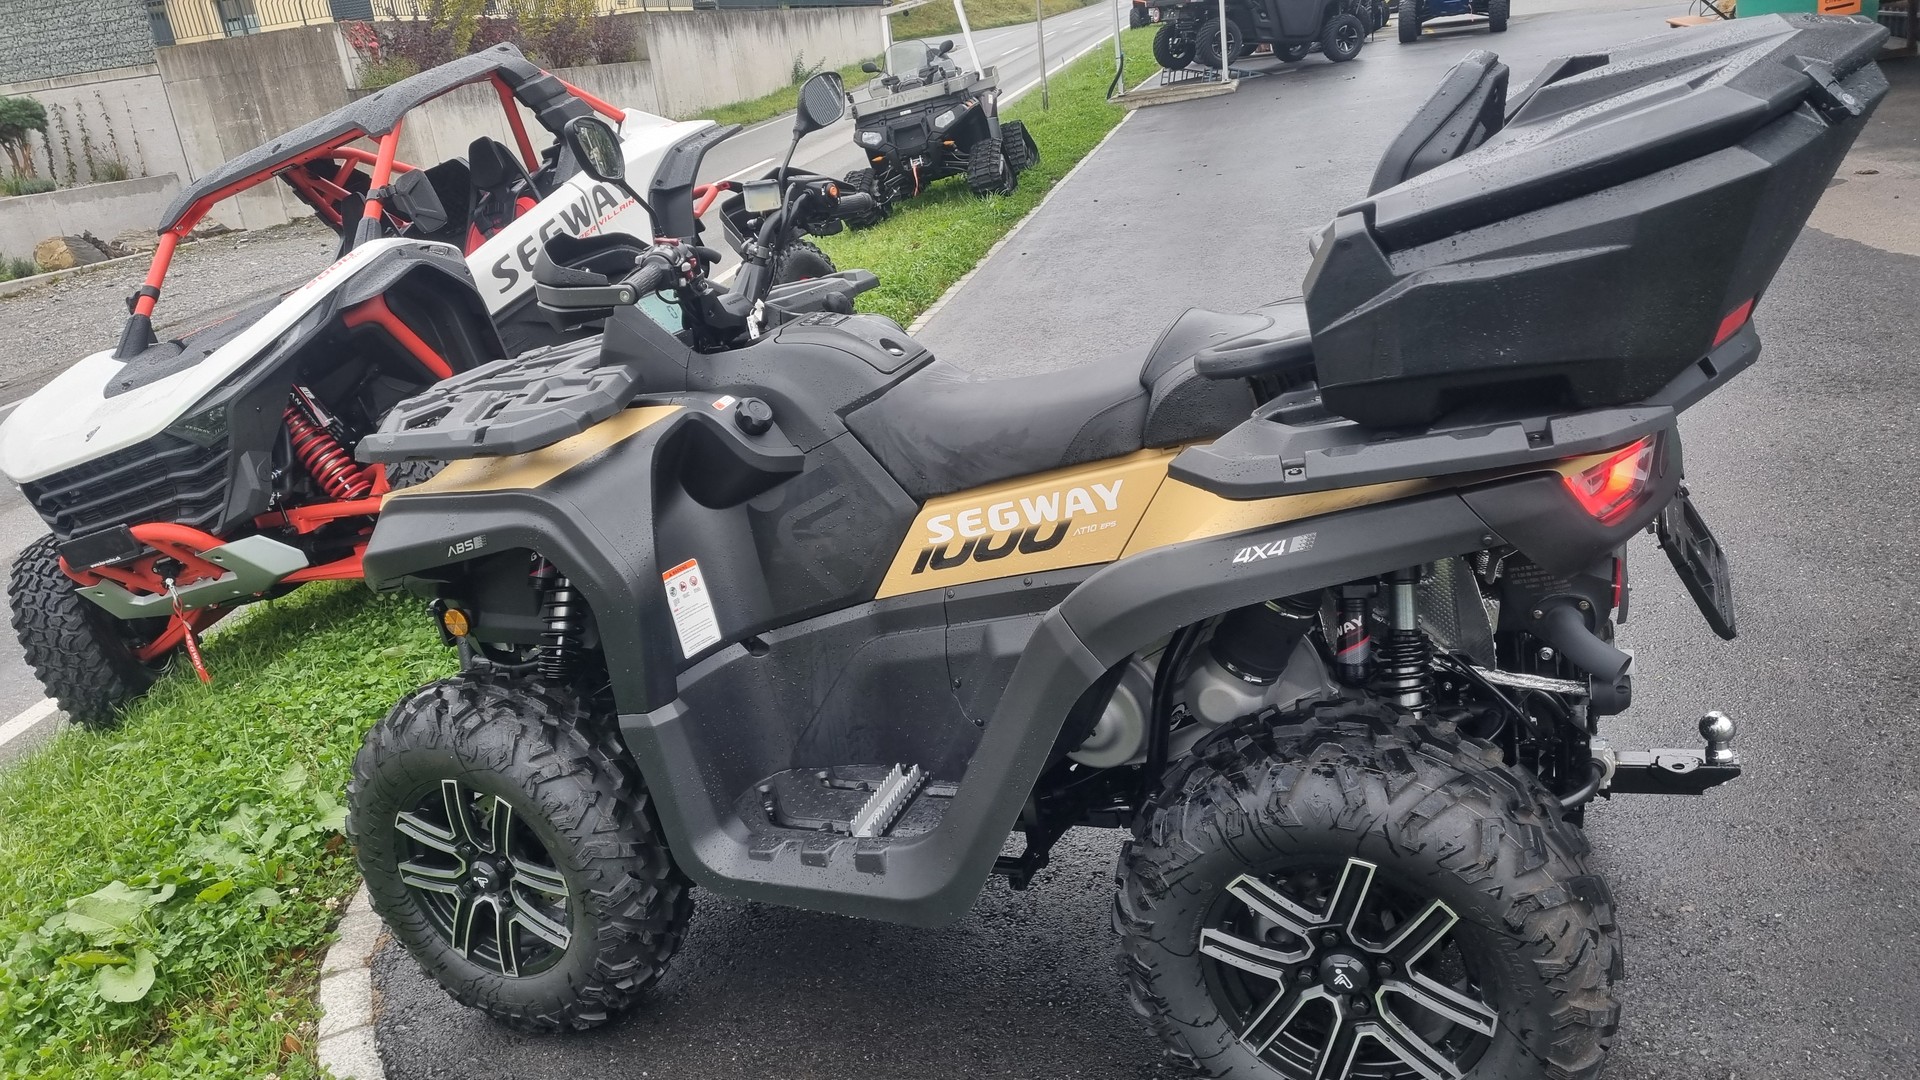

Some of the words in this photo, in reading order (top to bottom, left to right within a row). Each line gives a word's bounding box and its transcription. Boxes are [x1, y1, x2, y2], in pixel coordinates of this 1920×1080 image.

[598, 198, 635, 226] VILLAIN
[926, 479, 1124, 544] SEGWAY
[1073, 523, 1098, 537] AT10
[447, 539, 474, 558] ABS
[1232, 539, 1287, 564] 4X4
